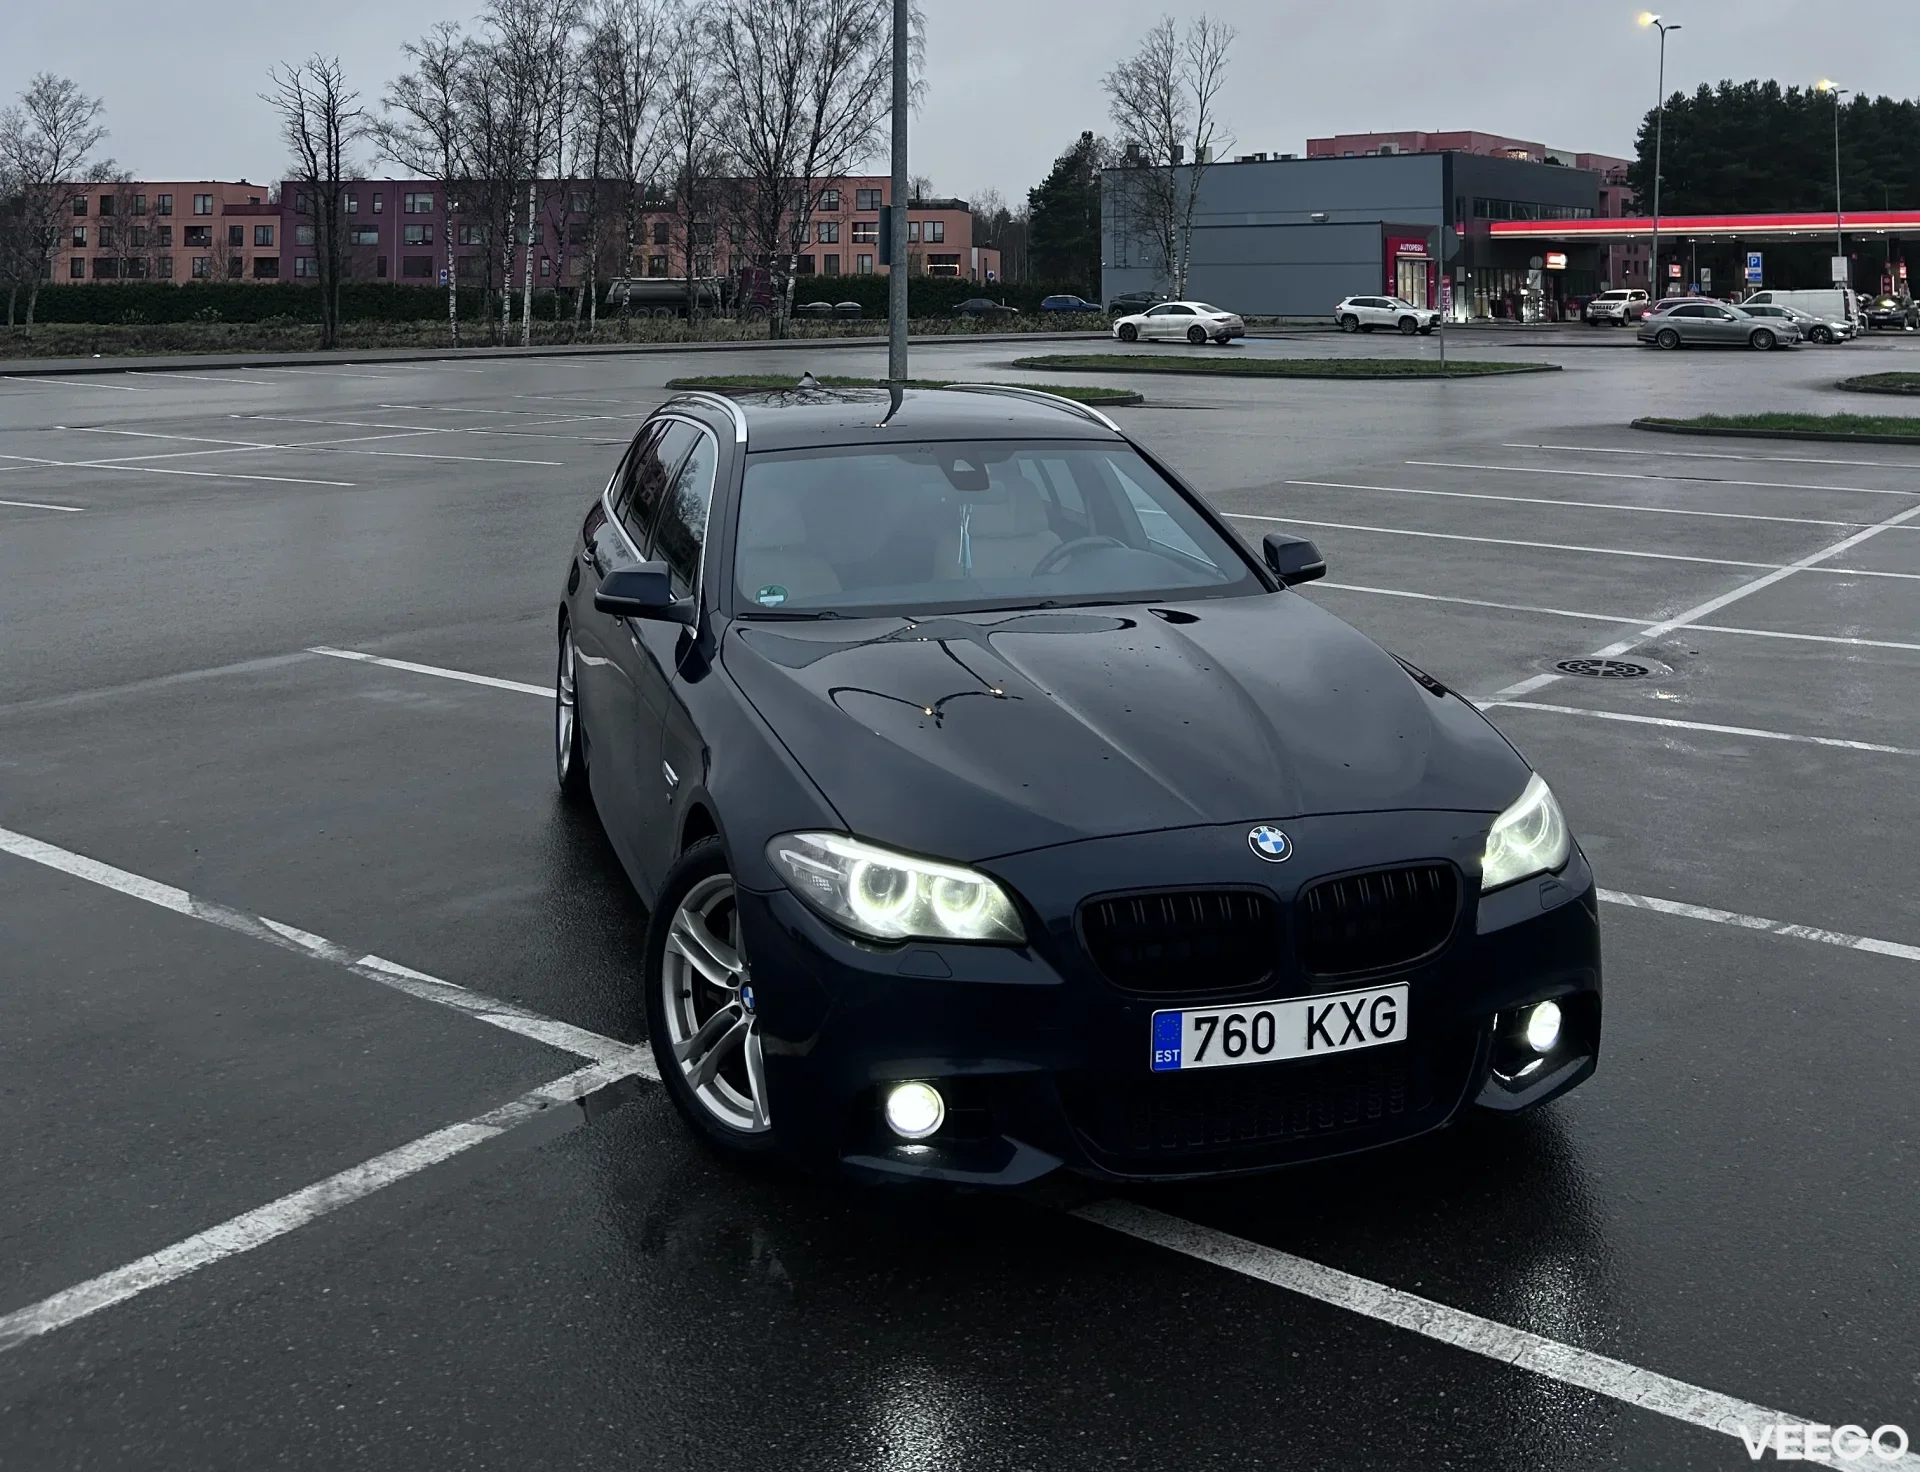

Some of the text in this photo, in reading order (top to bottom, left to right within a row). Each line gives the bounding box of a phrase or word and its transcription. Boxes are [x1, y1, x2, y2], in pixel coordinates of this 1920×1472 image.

[1750, 257, 1758, 267] P
[1194, 995, 1397, 1062] 760 KXG
[1155, 1049, 1180, 1063] EST
